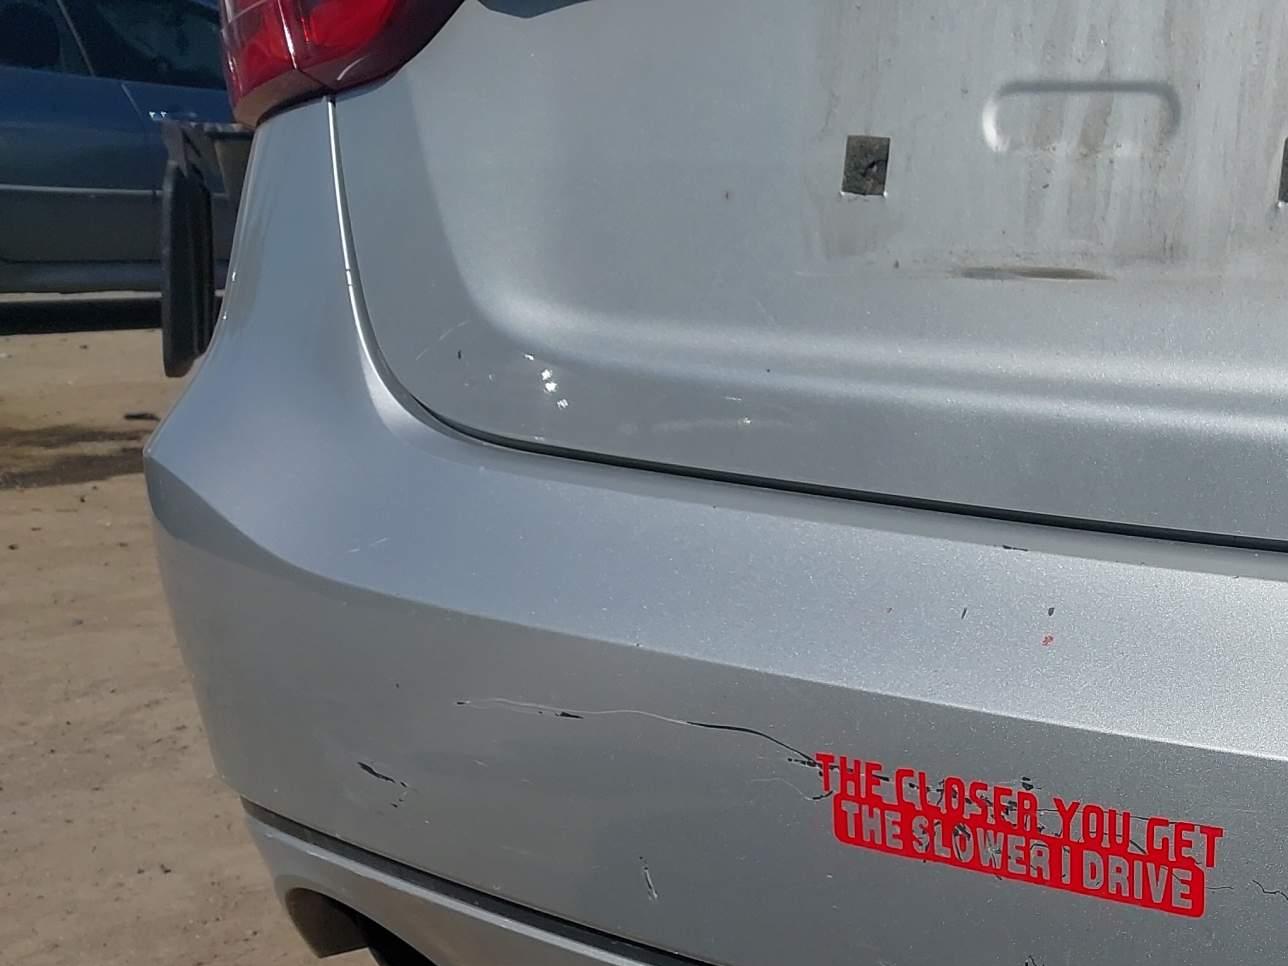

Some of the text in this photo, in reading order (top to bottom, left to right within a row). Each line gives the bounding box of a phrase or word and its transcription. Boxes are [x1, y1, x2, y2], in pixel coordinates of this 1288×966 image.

[816, 753, 1225, 867] THE CLOSER YOU GET
[841, 800, 1193, 910] THE SLOWER I DRIVE
